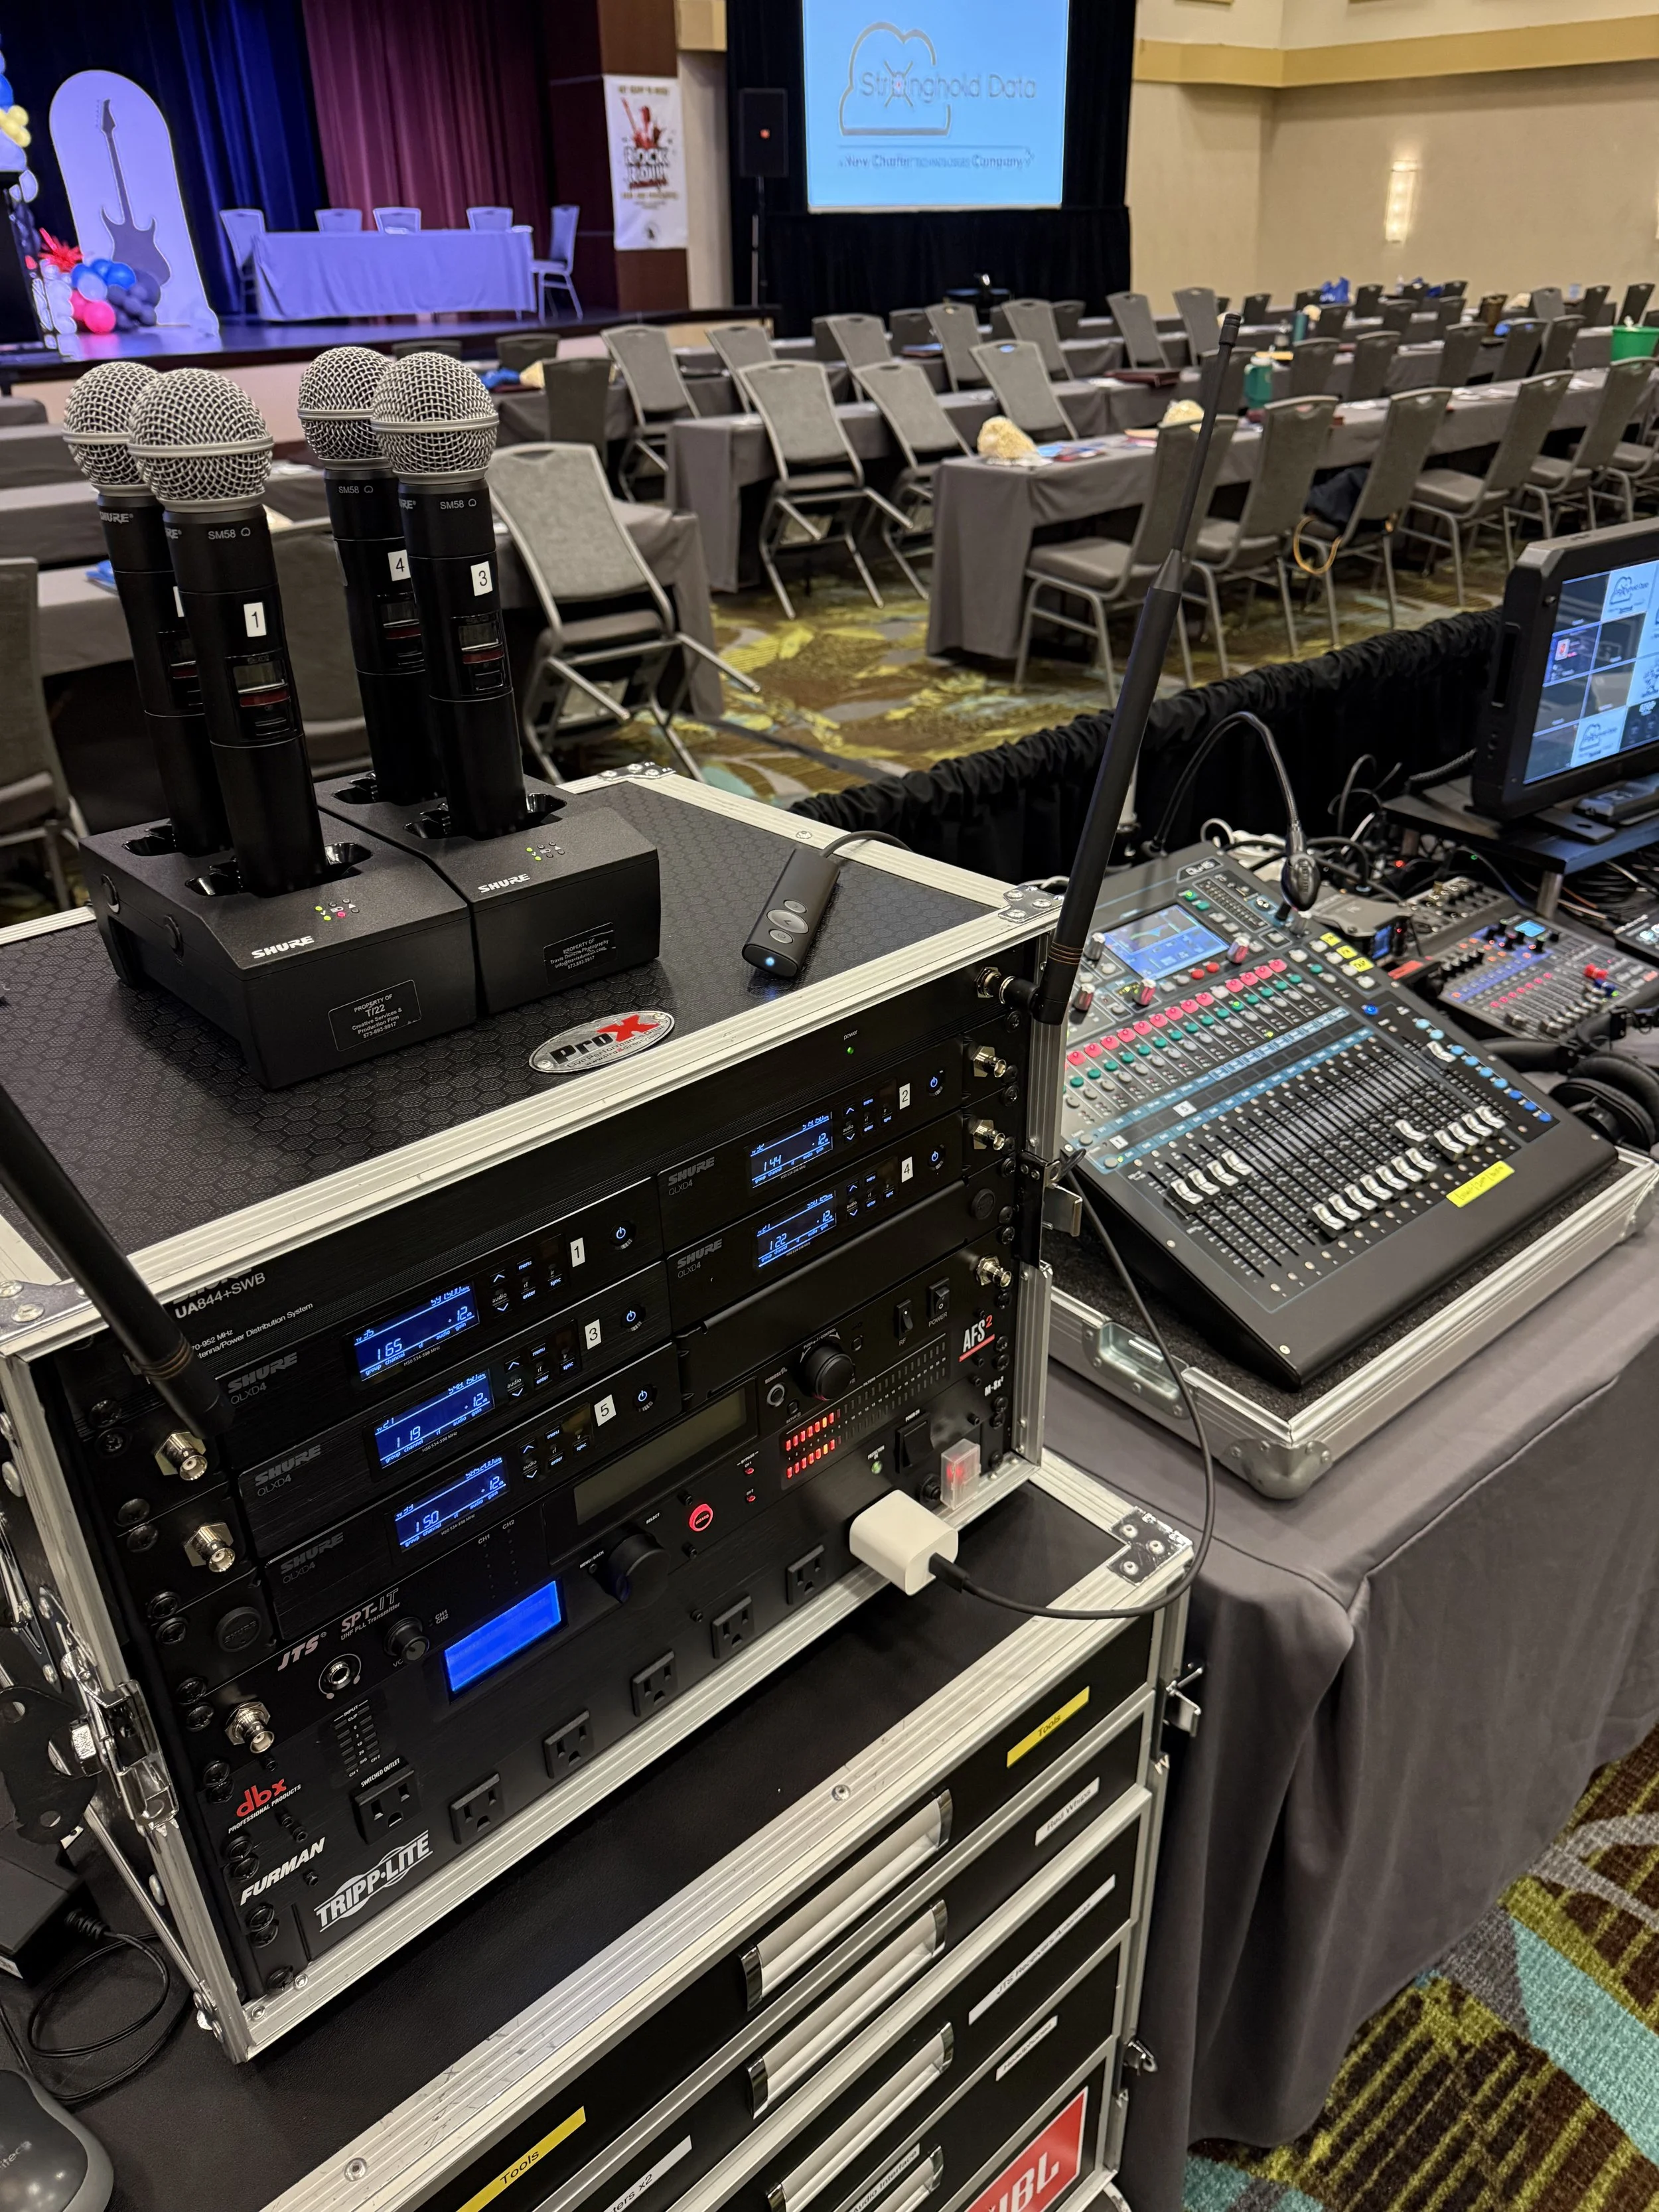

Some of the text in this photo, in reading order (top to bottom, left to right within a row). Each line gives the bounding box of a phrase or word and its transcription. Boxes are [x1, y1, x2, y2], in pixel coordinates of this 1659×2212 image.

[861, 70, 1036, 104] Stronghold Data
[972, 155, 1023, 171] Company
[338, 485, 360, 494] SM58
[440, 499, 465, 510] SM58
[208, 528, 236, 541] SM58
[396, 558, 405, 574] 4
[478, 571, 488, 587] 3
[251, 611, 259, 628] 1
[477, 873, 530, 893] SHURE
[251, 935, 315, 959] SHURE
[563, 940, 588, 954] PROPERTY
[581, 939, 609, 952] Photography
[353, 997, 385, 1013] PROPERTY
[365, 1003, 386, 1017] T/22
[352, 1019, 374, 1031] Creative
[374, 1010, 397, 1021] Services
[358, 1015, 399, 1035] Production Firm
[549, 1014, 660, 1065] ProX
[843, 1029, 858, 1041] power
[585, 1034, 644, 1061] Performance
[902, 1090, 908, 1103] 2
[668, 1156, 715, 1187] SHURE
[904, 1163, 910, 1174] 4
[668, 1179, 693, 1196] QLXD4
[574, 1246, 580, 1259] 1
[677, 1238, 723, 1270] SHURE
[518, 1260, 532, 1271] menu
[677, 1261, 701, 1279] QLXD4
[550, 1278, 561, 1288] sync
[175, 1271, 266, 1319] UA844+SWB
[492, 1293, 508, 1303] audio
[522, 1290, 536, 1300] enter
[246, 1315, 286, 1338] Distribution
[286, 1302, 314, 1319] System
[928, 1311, 948, 1327] POWER
[216, 1329, 233, 1341] MHz
[589, 1327, 599, 1341] 3
[899, 1337, 907, 1347] RF
[365, 1322, 467, 1376] group channel audio gain
[532, 1347, 545, 1357] menu
[228, 1351, 298, 1394] SHURE
[563, 1361, 574, 1371] sync
[506, 1376, 522, 1389] audio
[536, 1374, 549, 1385] enter
[230, 1382, 267, 1405] QLXD4
[601, 1403, 609, 1417] 5
[385, 1407, 483, 1464] group channel audio gain
[409, 1426, 421, 1441] 19
[546, 1429, 560, 1440] menu
[576, 1441, 587, 1451] sync
[254, 1444, 322, 1487] SHURE
[522, 1459, 538, 1471] audio
[550, 1455, 563, 1466] enter
[257, 1473, 293, 1497] QLXD4
[405, 1535, 420, 1548] group
[422, 1522, 442, 1536] channel
[469, 1499, 484, 1510] audio
[502, 1518, 515, 1530] CH2
[646, 1512, 661, 1524] SELECT
[478, 1533, 490, 1545] CH1
[280, 1531, 344, 1575] SHURE
[282, 1561, 316, 1584] QLXD4
[340, 1601, 401, 1641] UHF PLL Transmitter
[435, 1609, 448, 1619] CH1
[435, 1613, 449, 1625] CH2
[277, 1634, 320, 1672] JTS
[343, 1704, 358, 1717] INPUT
[1037, 1714, 1061, 1737] Tools
[360, 1757, 401, 1789] SWITCHED OUTLET
[236, 1778, 287, 1818] dbx
[228, 1783, 302, 1834] PROFESSIONAL PRODUCTS
[239, 1836, 326, 1907] FURMAN
[996, 1975, 1014, 1995] JTS
[500, 2150, 540, 2185] Tools
[879, 2150, 917, 2189] Interface
[639, 2173, 653, 2191] x2
